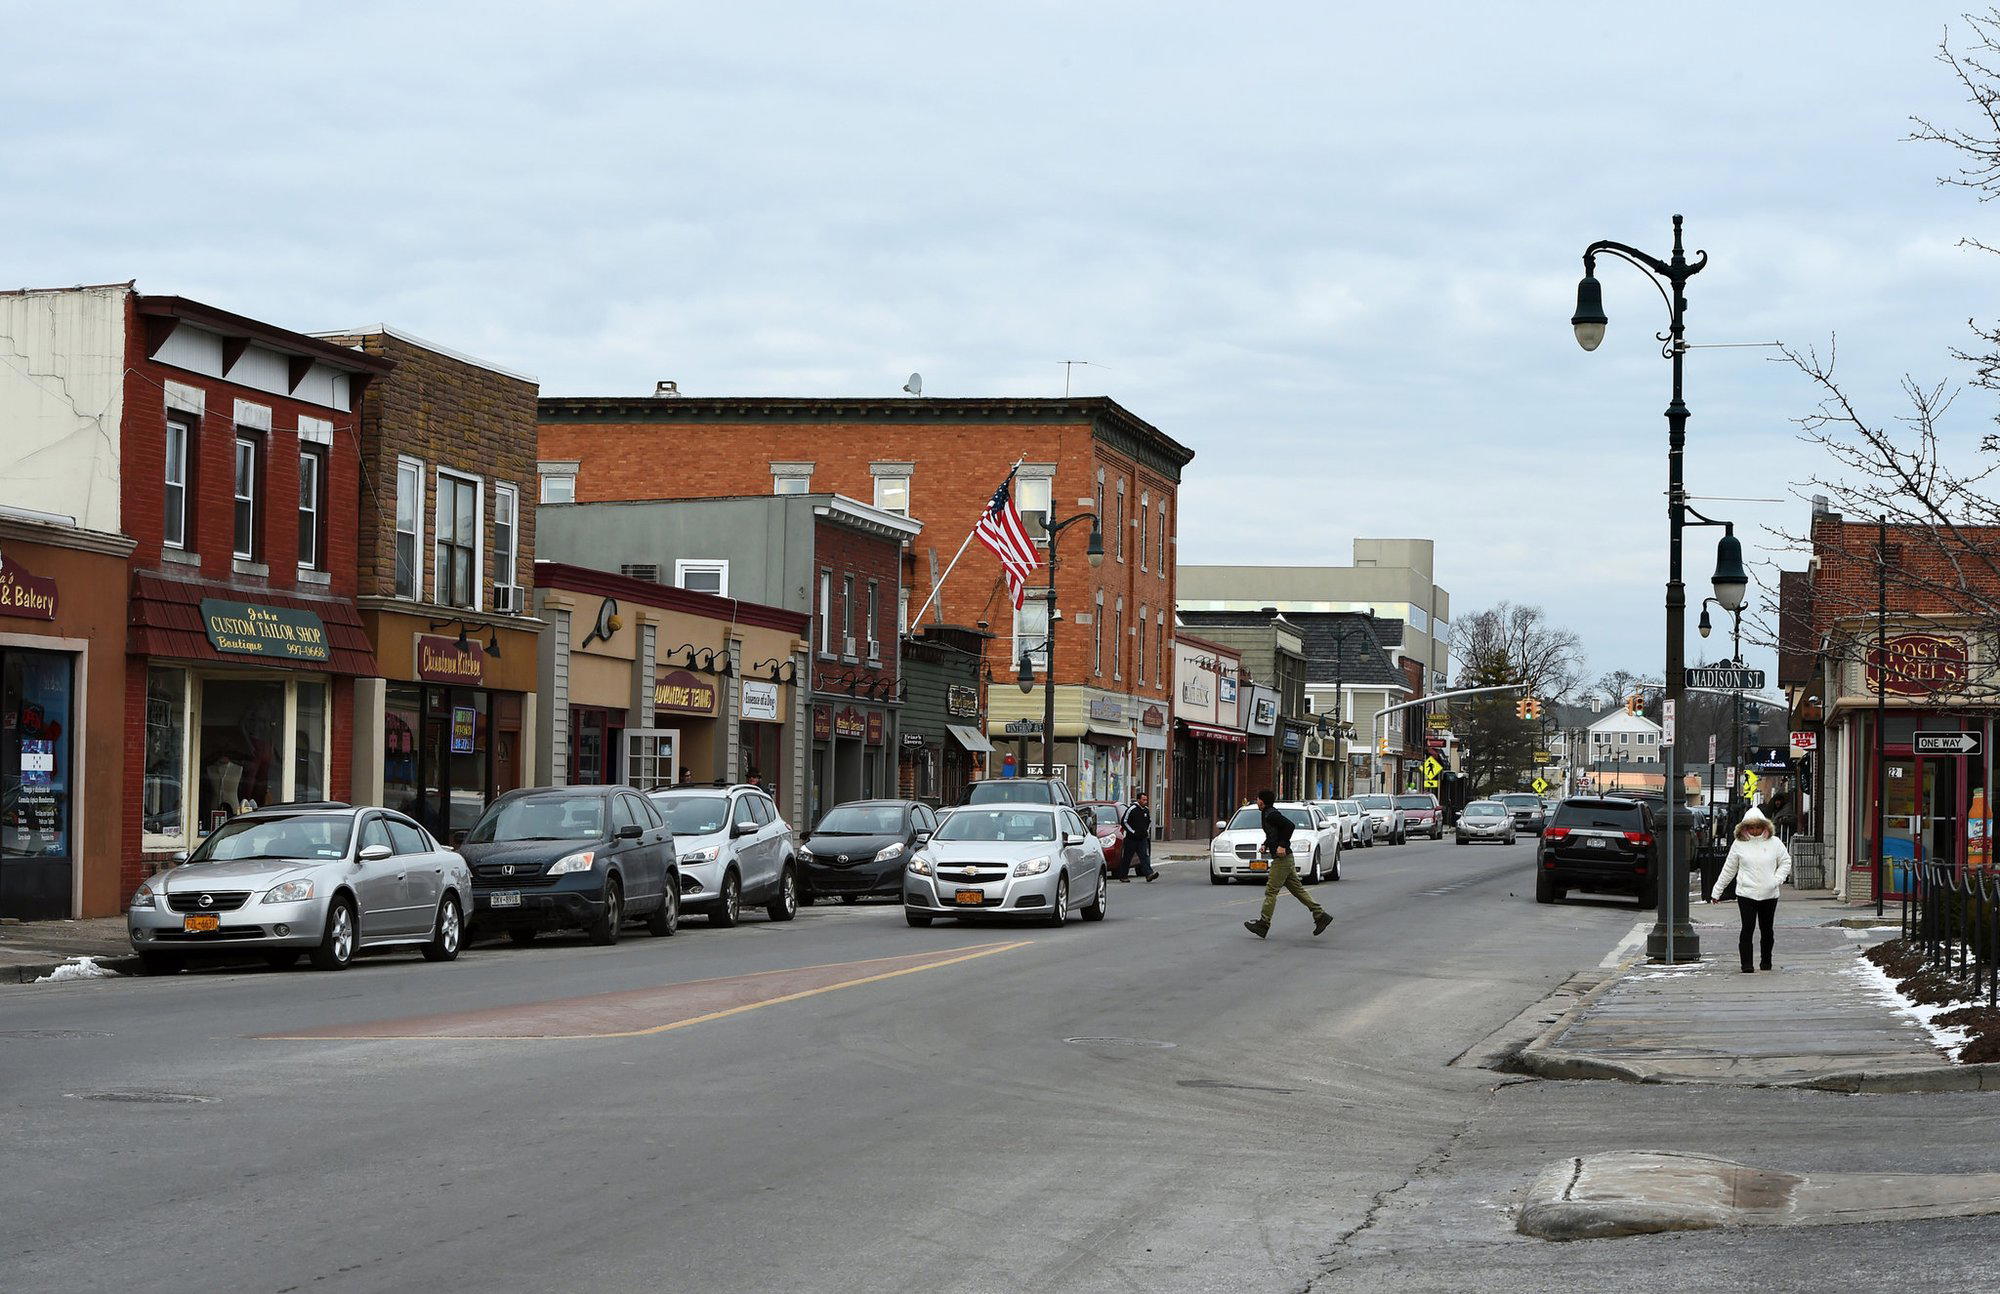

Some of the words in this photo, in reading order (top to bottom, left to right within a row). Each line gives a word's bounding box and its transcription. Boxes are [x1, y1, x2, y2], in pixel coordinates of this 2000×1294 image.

[1, 585, 11, 606] &
[15, 586, 54, 616] Bakery
[248, 608, 278, 621] John
[211, 616, 256, 636] CUSTOM
[256, 621, 296, 641] TAILOR
[295, 626, 321, 643] SHOP
[216, 636, 263, 653] Boutique
[1890, 643, 1943, 662] POST
[424, 645, 457, 674] Chinatown
[457, 650, 480, 677] Kitchen
[1691, 670, 1741, 687] MADISON
[1747, 671, 1762, 688] ST.
[654, 685, 690, 706] ADVANTAGE
[690, 688, 712, 709] TENNIS
[1921, 738, 1939, 748] ONE
[1941, 738, 1961, 748] WAY
[1027, 767, 1064, 775] BEATY
